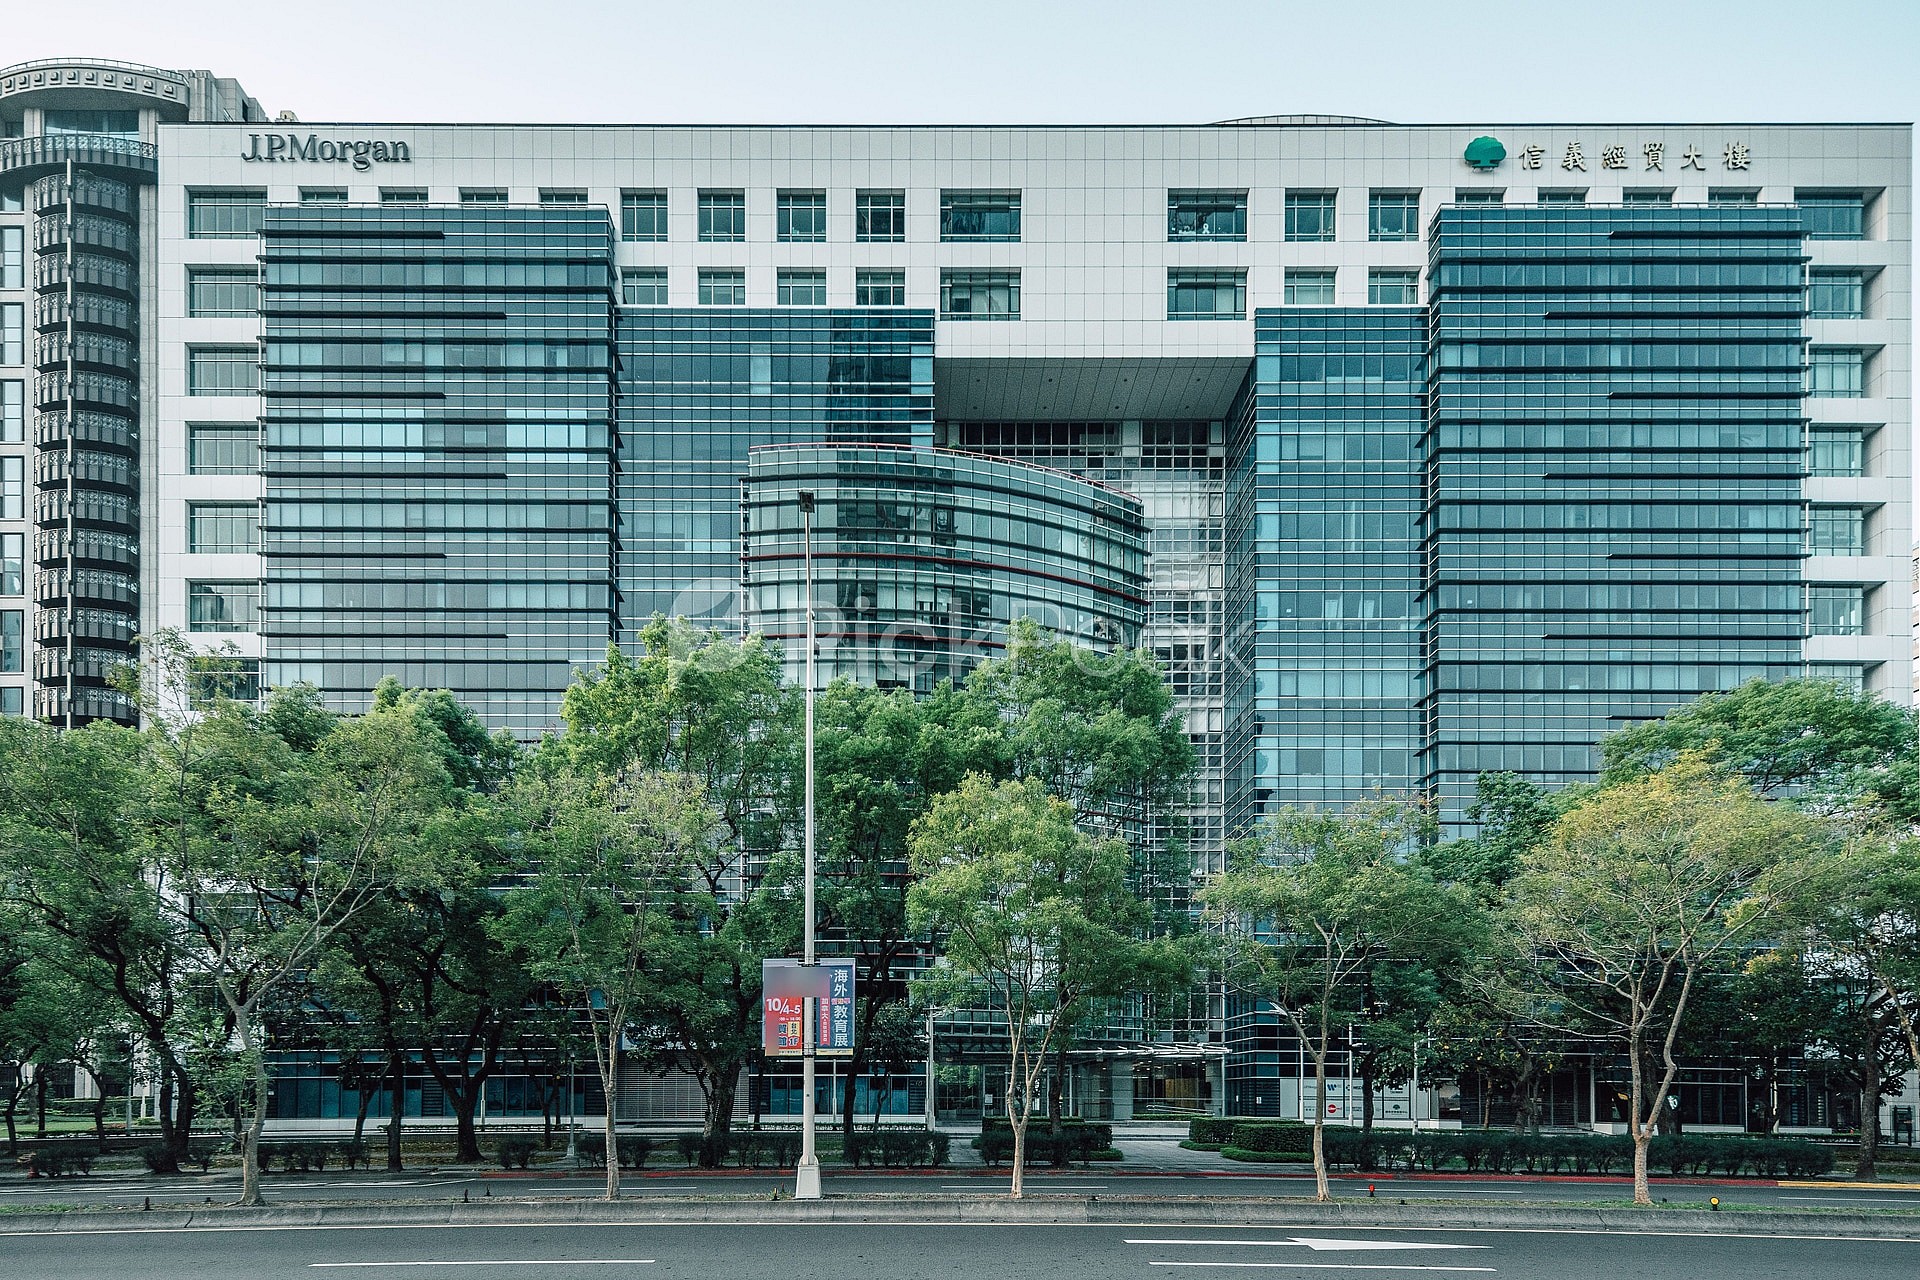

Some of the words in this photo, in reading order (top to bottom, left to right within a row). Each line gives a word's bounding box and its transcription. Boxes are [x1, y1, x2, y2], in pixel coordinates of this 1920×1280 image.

[241, 134, 411, 171] J.P.Morgan
[1519, 140, 1751, 172] 信義經貿大樓
